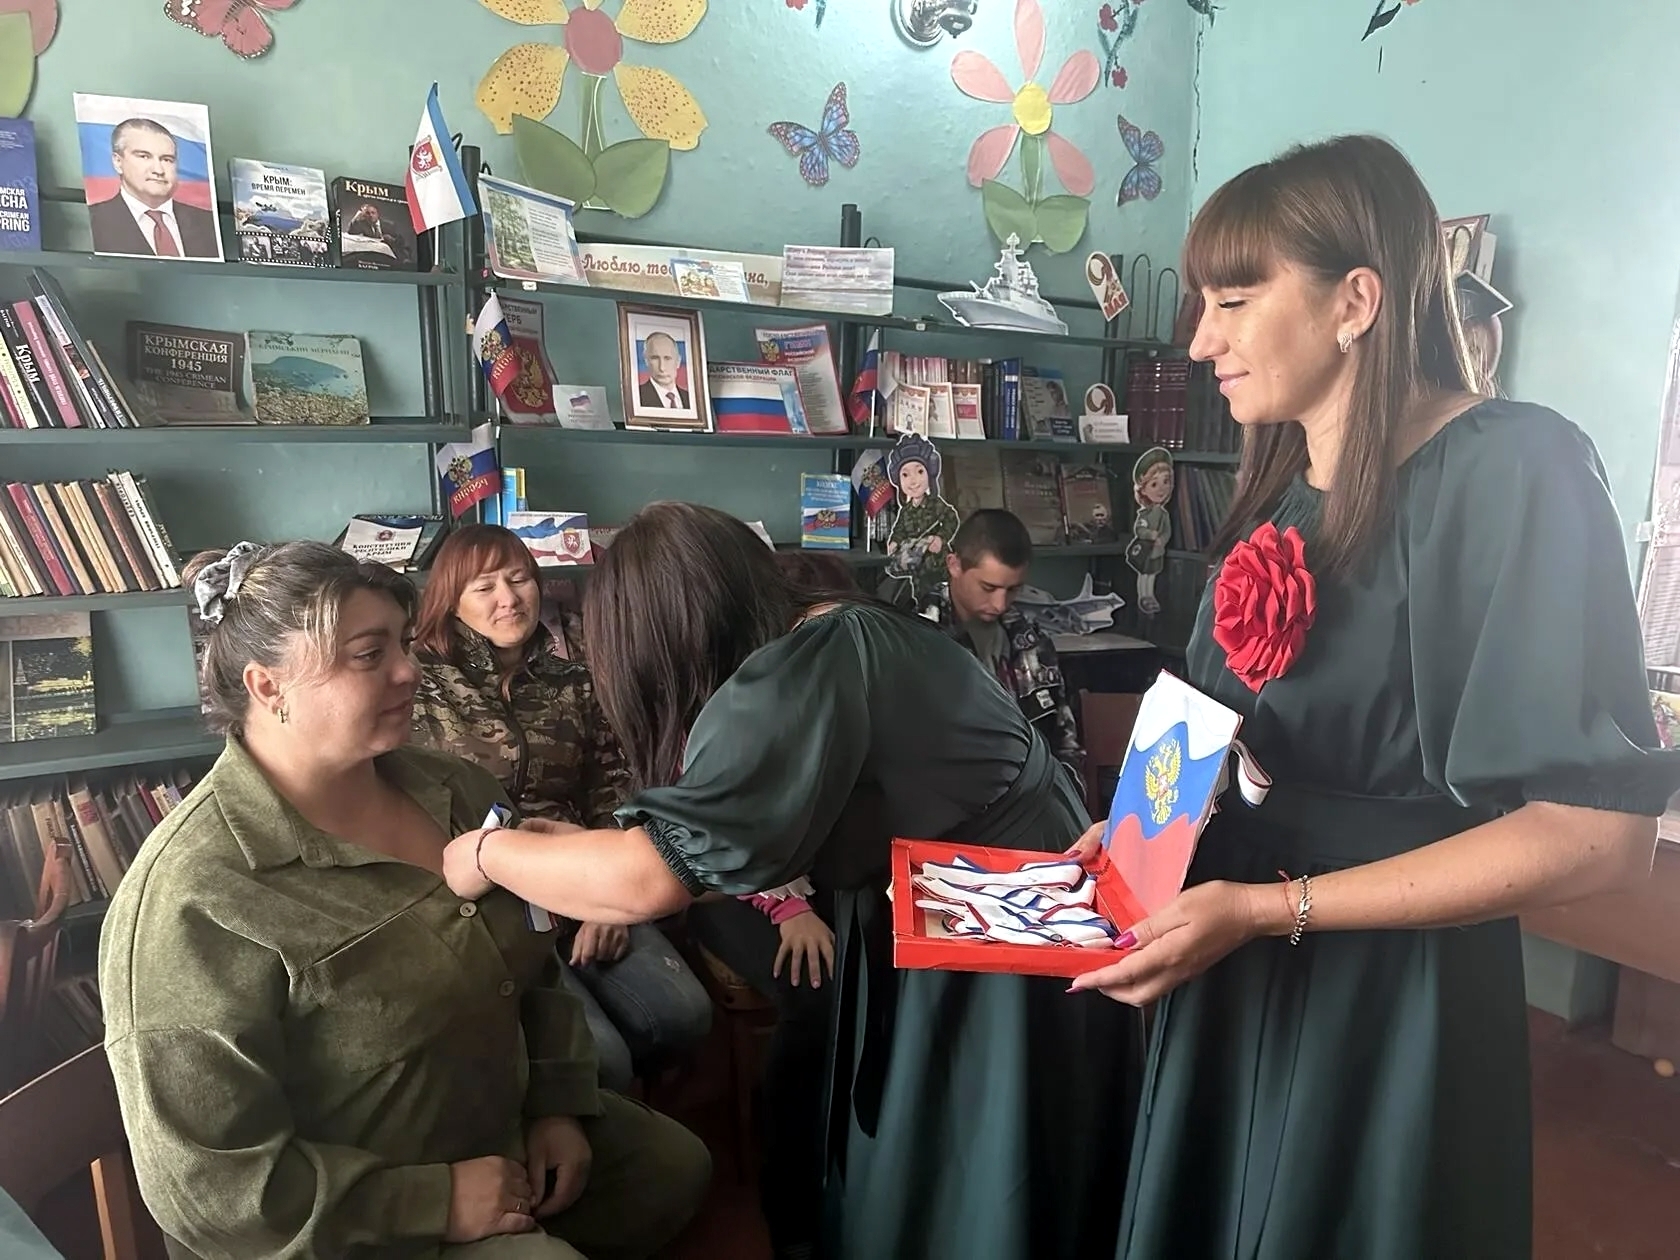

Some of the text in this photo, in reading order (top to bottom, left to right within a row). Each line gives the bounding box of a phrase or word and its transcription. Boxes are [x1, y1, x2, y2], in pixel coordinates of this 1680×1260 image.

[345, 180, 389, 198] Крым
[581, 253, 640, 275] Люблю
[144, 334, 229, 355] КРЫМСКАЯ
[144, 345, 228, 363] КОНФЕРЕНЦИЯ
[171, 358, 202, 372] 1945
